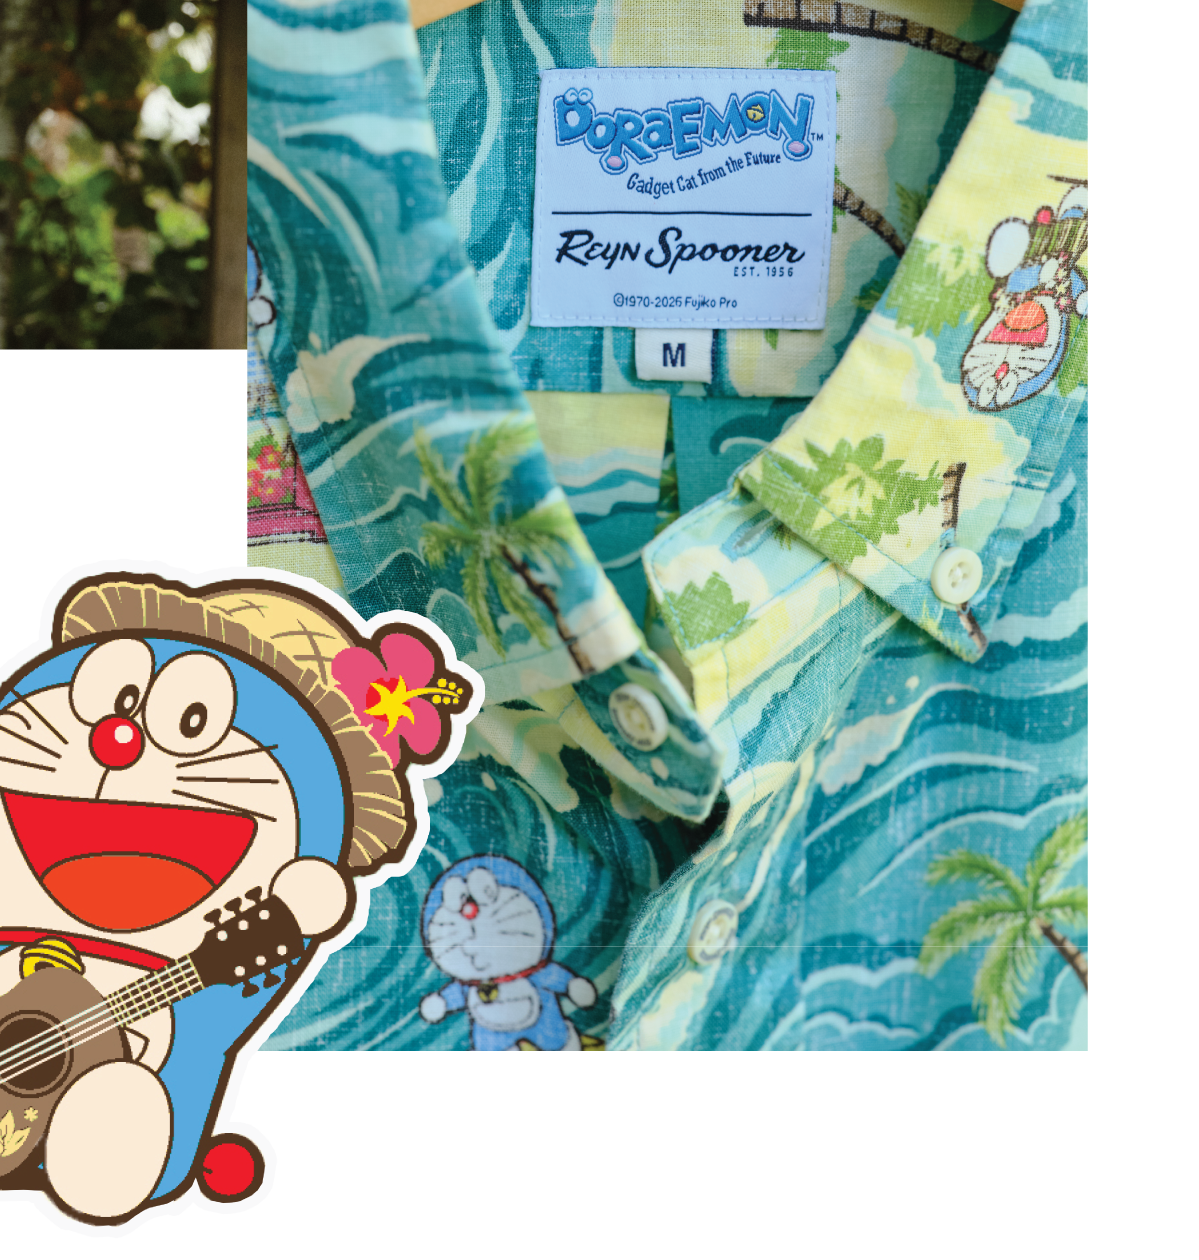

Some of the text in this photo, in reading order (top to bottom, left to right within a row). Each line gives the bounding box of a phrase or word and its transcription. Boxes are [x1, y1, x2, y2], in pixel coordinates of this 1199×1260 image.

[626, 151, 782, 200] Gadget Cat from the Future
[644, 226, 806, 275] Spooner
[733, 266, 795, 278] EST. 1956
[684, 294, 717, 311] Fujiko
[719, 296, 739, 309] Pro
[662, 342, 687, 368] M
